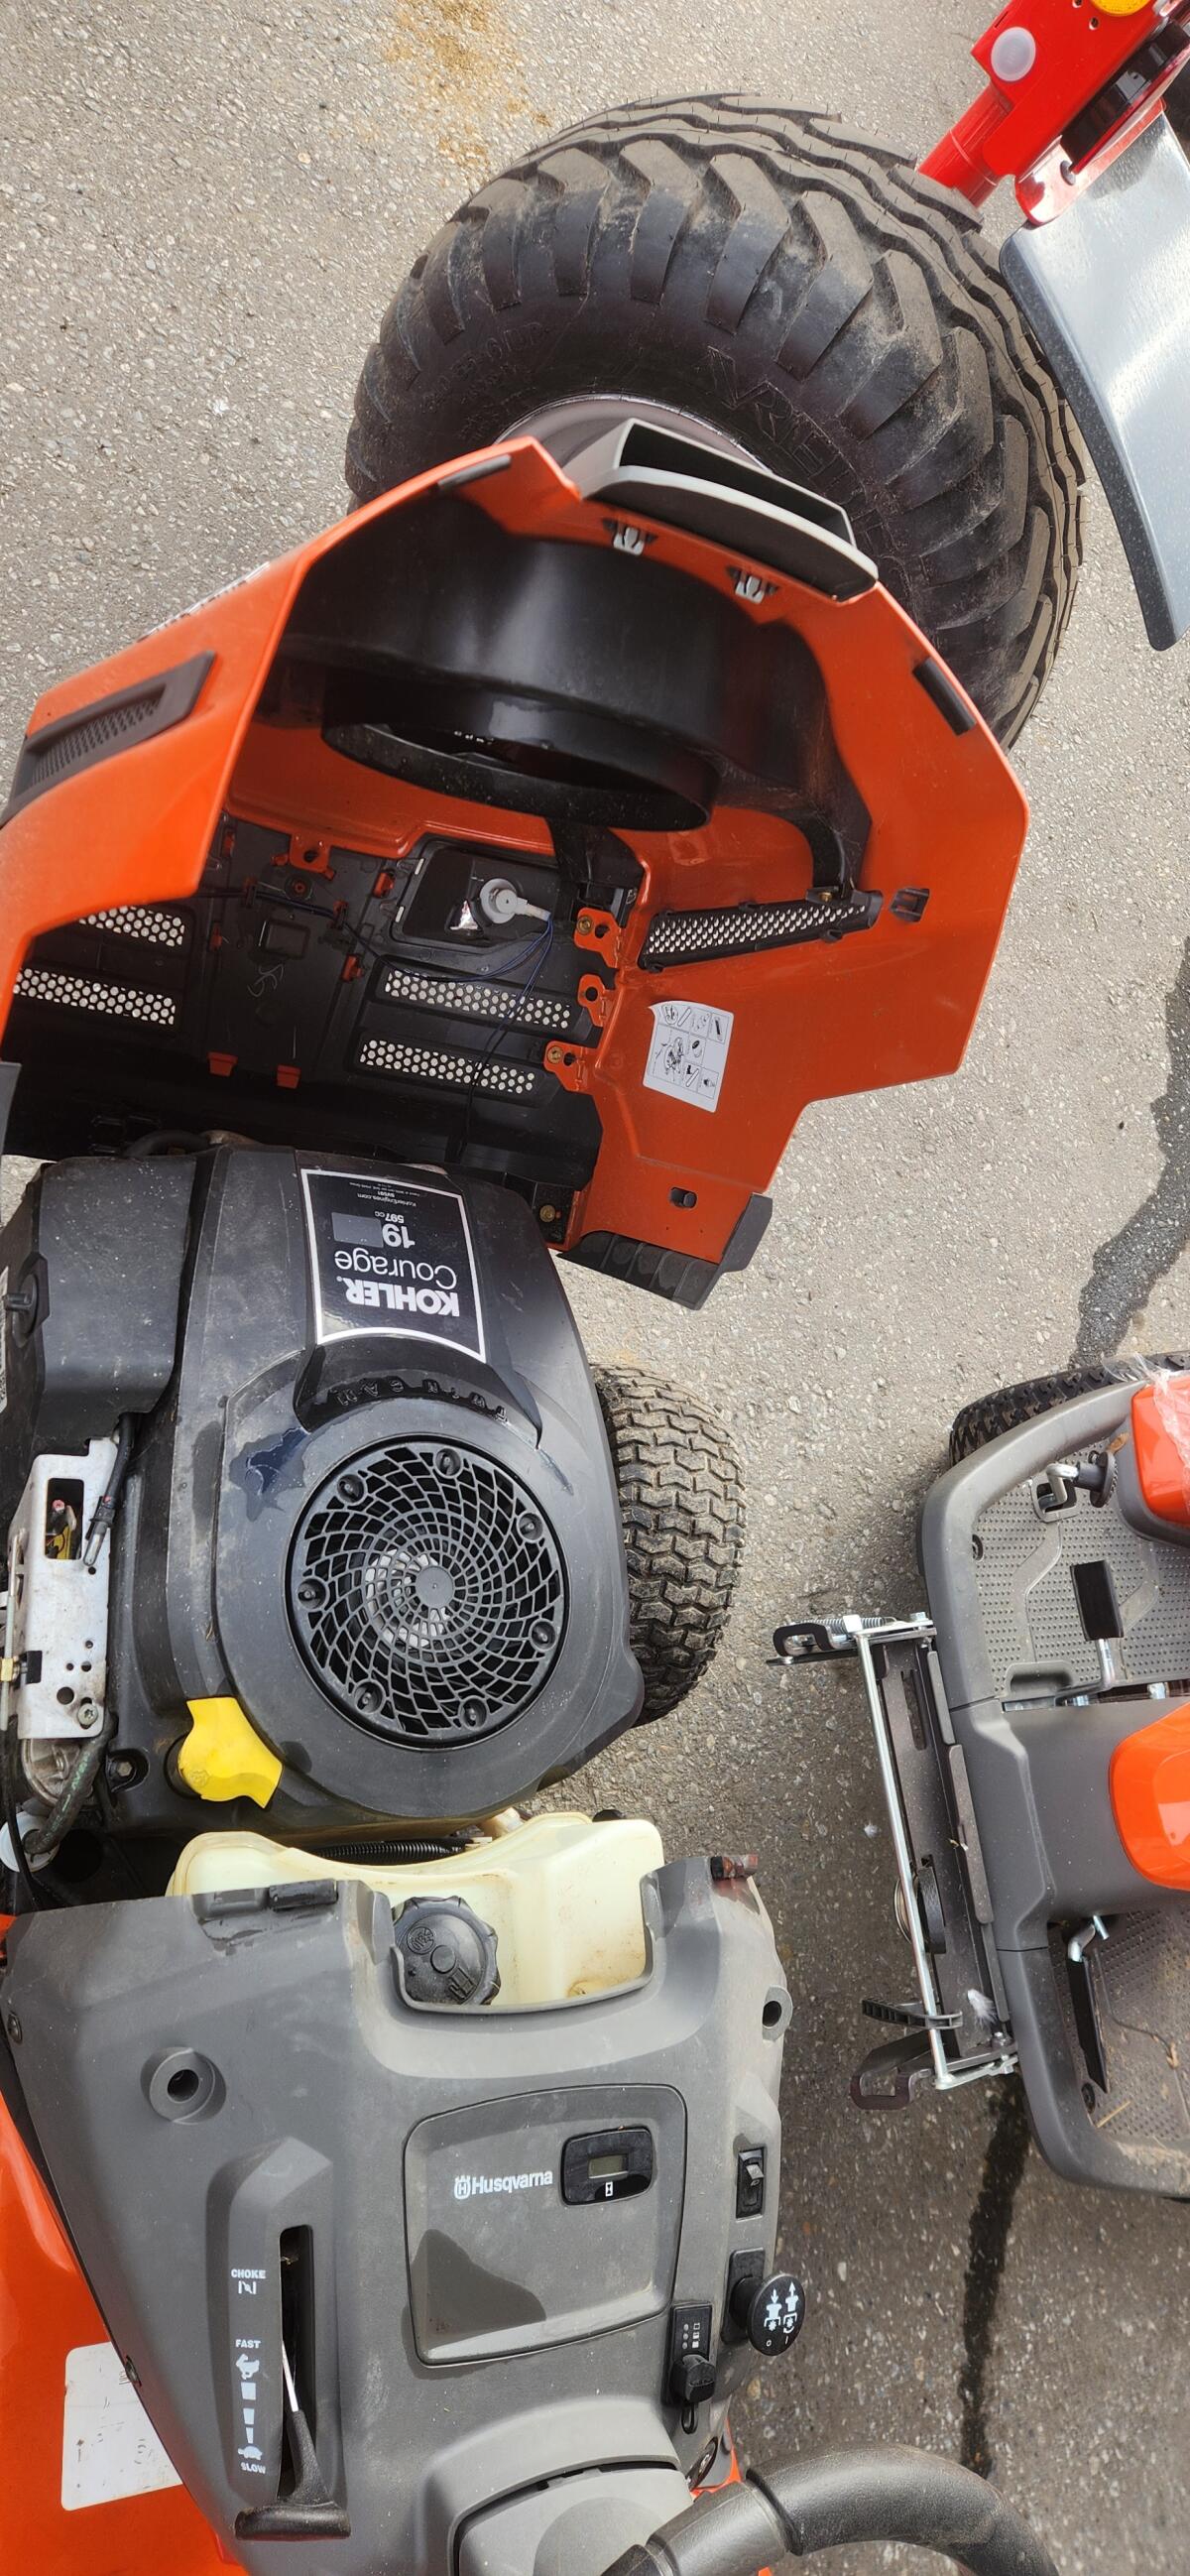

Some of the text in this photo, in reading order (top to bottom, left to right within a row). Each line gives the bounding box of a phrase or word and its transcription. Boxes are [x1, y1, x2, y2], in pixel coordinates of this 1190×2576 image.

[382, 1223, 416, 1250] 19
[334, 1248, 457, 1290] Courage
[471, 2170, 553, 2194] Husqvarna
[230, 2269, 266, 2279] CHOKE
[235, 2339, 261, 2349] FAST
[240, 2462, 266, 2474] SLOW
